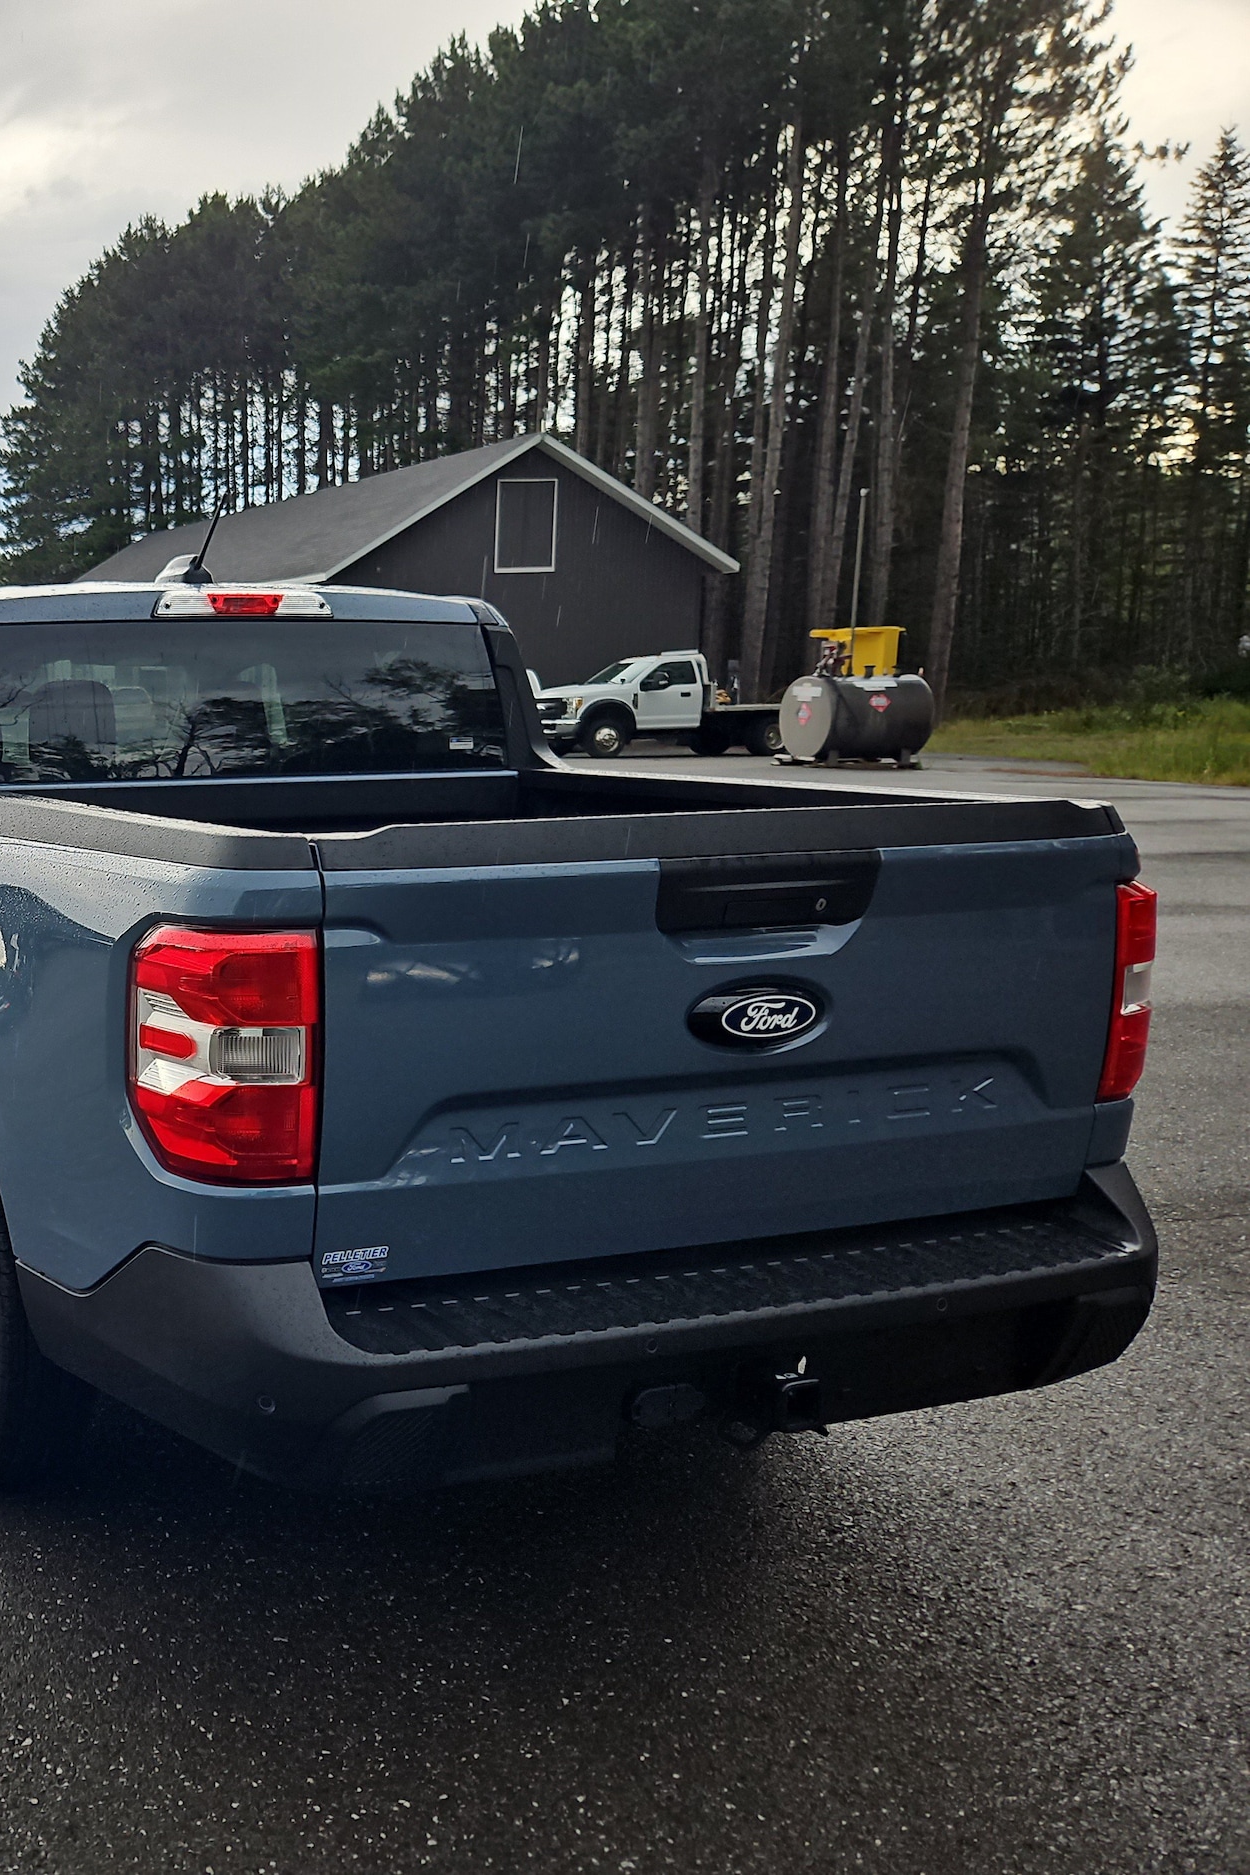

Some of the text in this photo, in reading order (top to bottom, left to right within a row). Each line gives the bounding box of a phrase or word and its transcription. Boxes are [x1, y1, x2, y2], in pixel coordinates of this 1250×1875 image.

[740, 1001, 800, 1031] Ford
[449, 1076, 997, 1164] MAVERICK
[321, 1245, 390, 1265] PELLETIER
